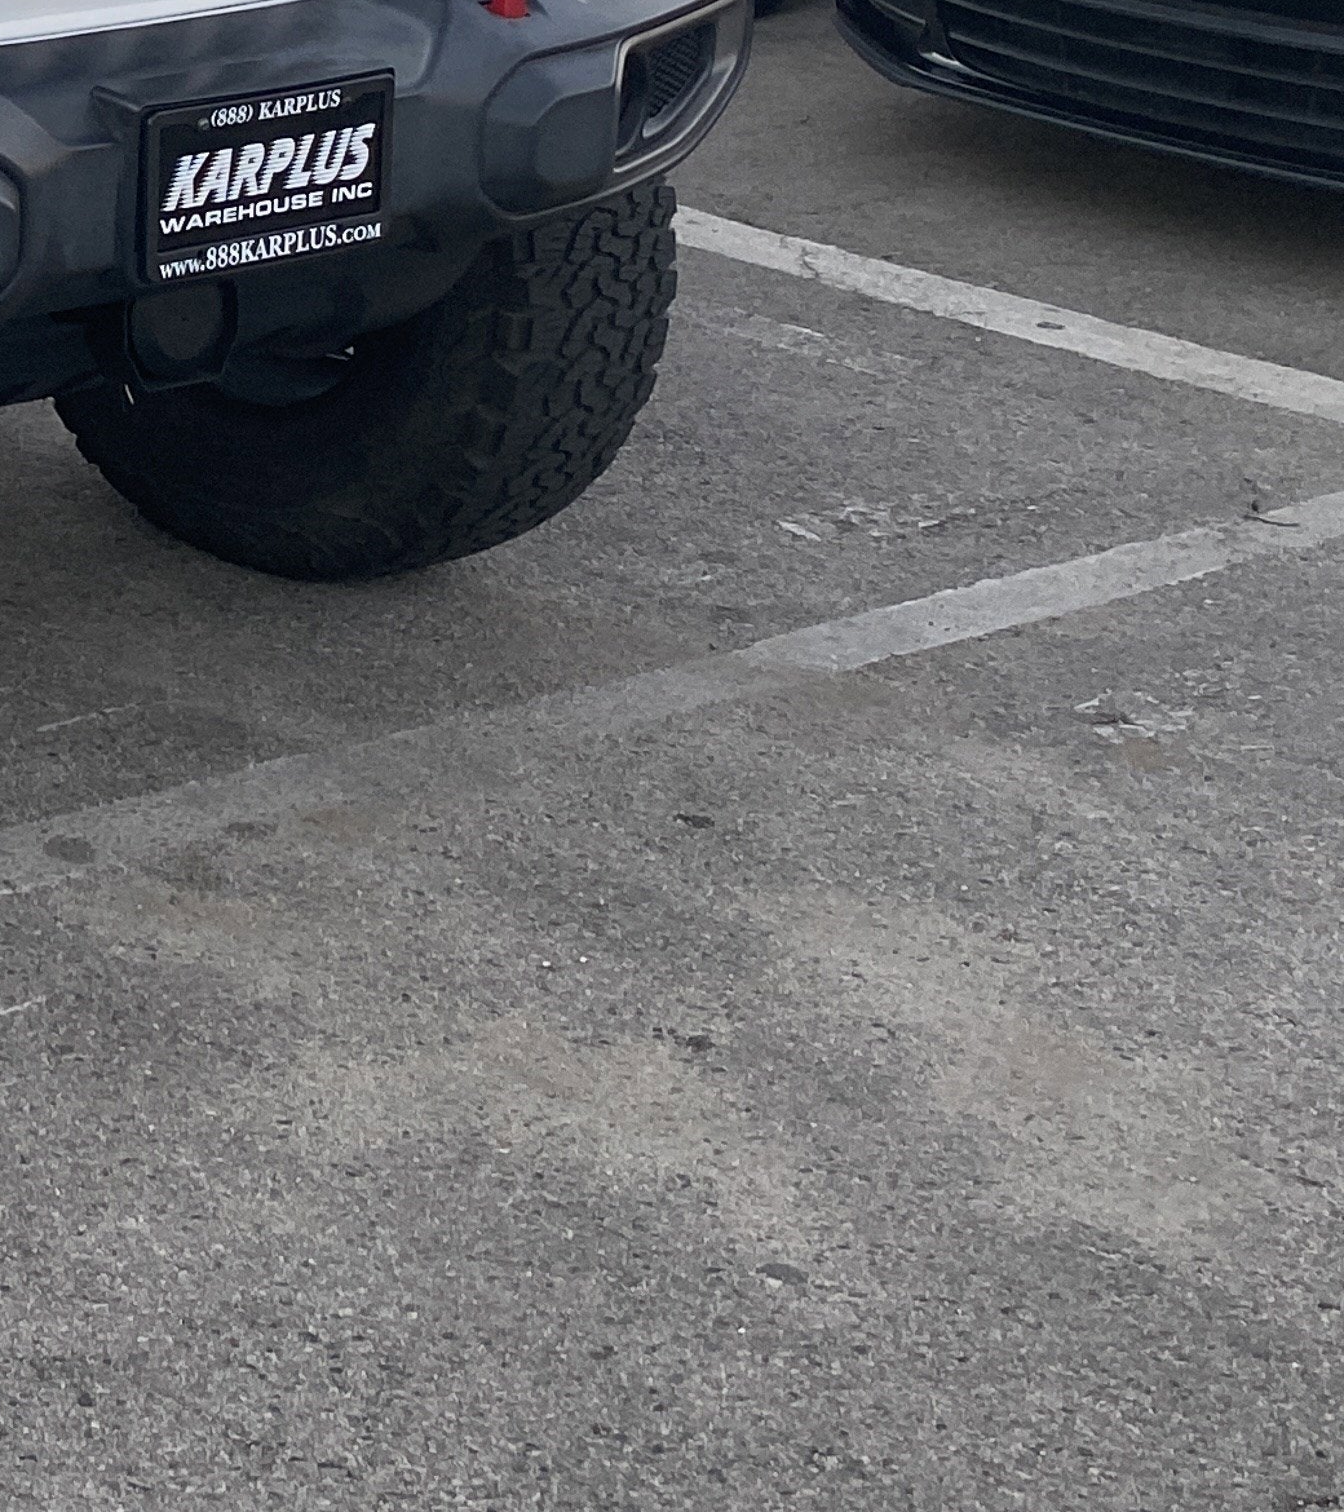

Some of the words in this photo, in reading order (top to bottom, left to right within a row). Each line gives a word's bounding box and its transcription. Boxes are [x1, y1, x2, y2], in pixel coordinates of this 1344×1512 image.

[210, 105, 254, 128] (888)
[258, 89, 341, 121] KARPLUS
[160, 122, 376, 213] KARPLUS
[159, 190, 324, 235] WAREHOUSE
[331, 182, 374, 203] INC
